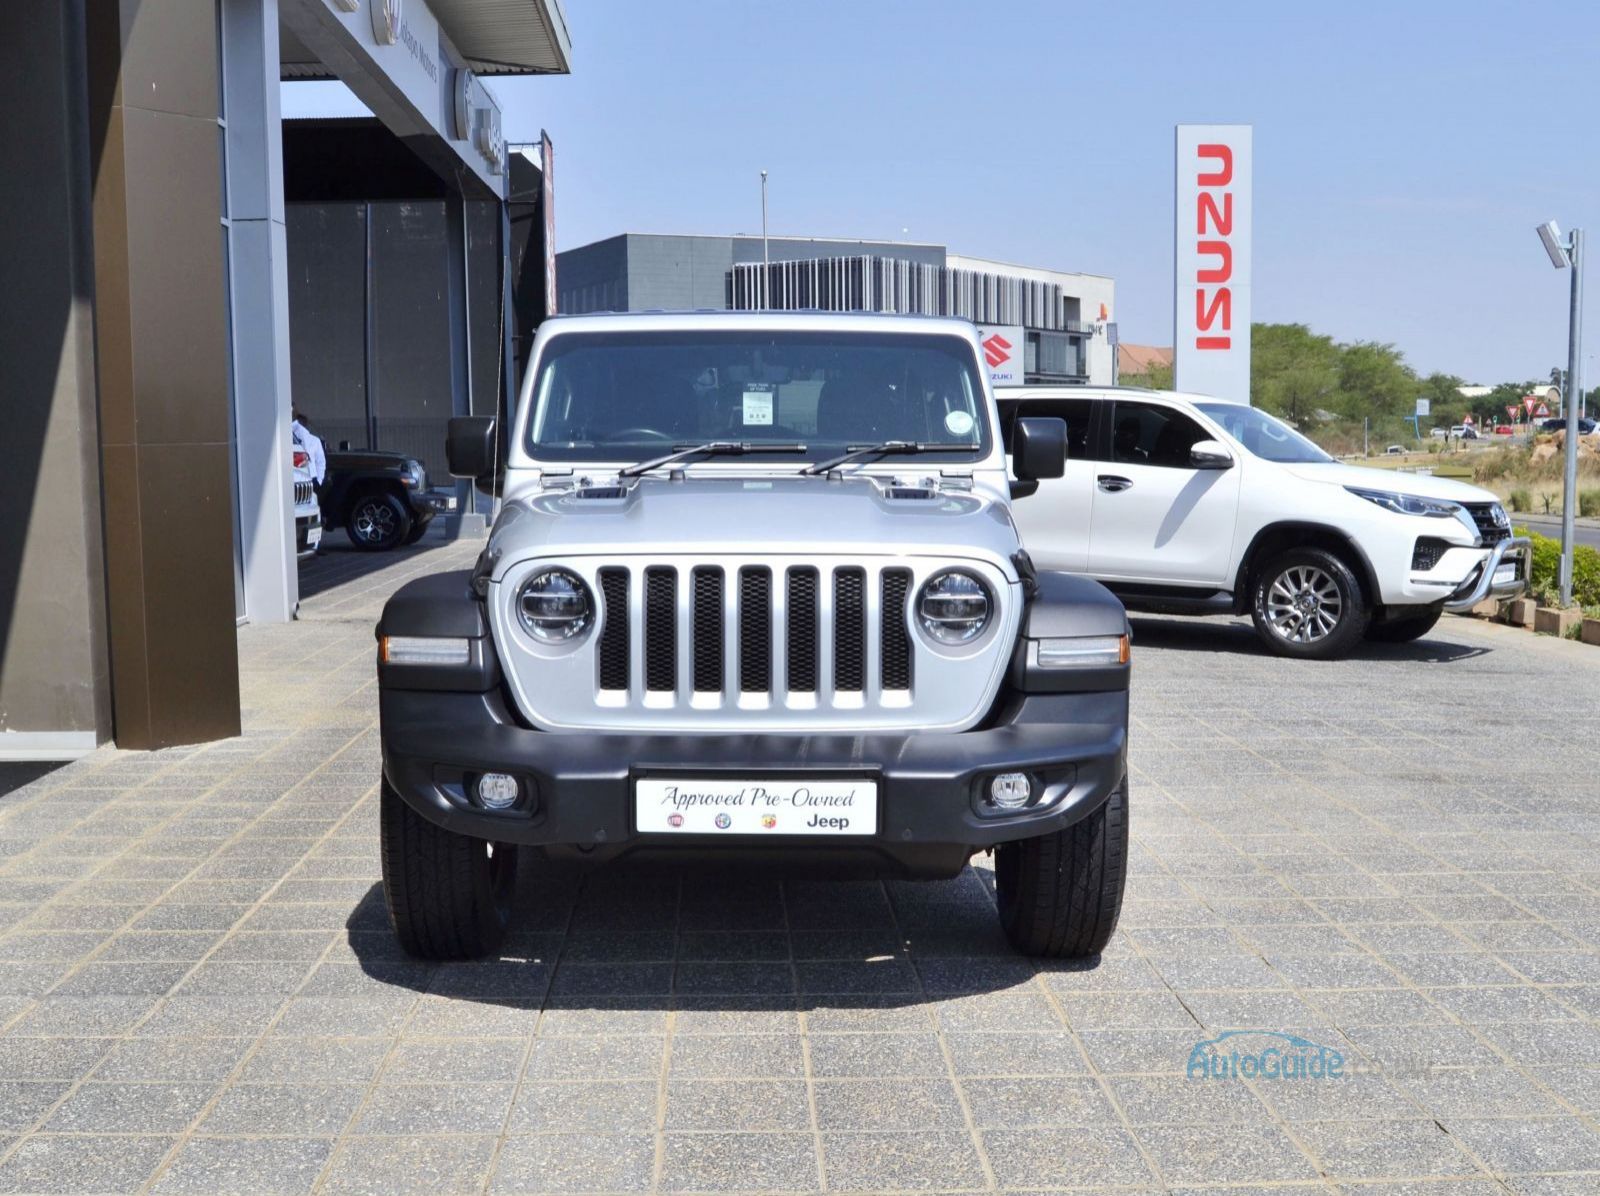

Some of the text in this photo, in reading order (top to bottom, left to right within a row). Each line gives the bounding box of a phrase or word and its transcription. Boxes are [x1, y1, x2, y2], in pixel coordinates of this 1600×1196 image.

[1196, 144, 1233, 350] ISUZU
[991, 373, 1013, 381] ZUKI
[661, 786, 855, 810] Approved Pre-Owned
[806, 813, 850, 831] Jeep
